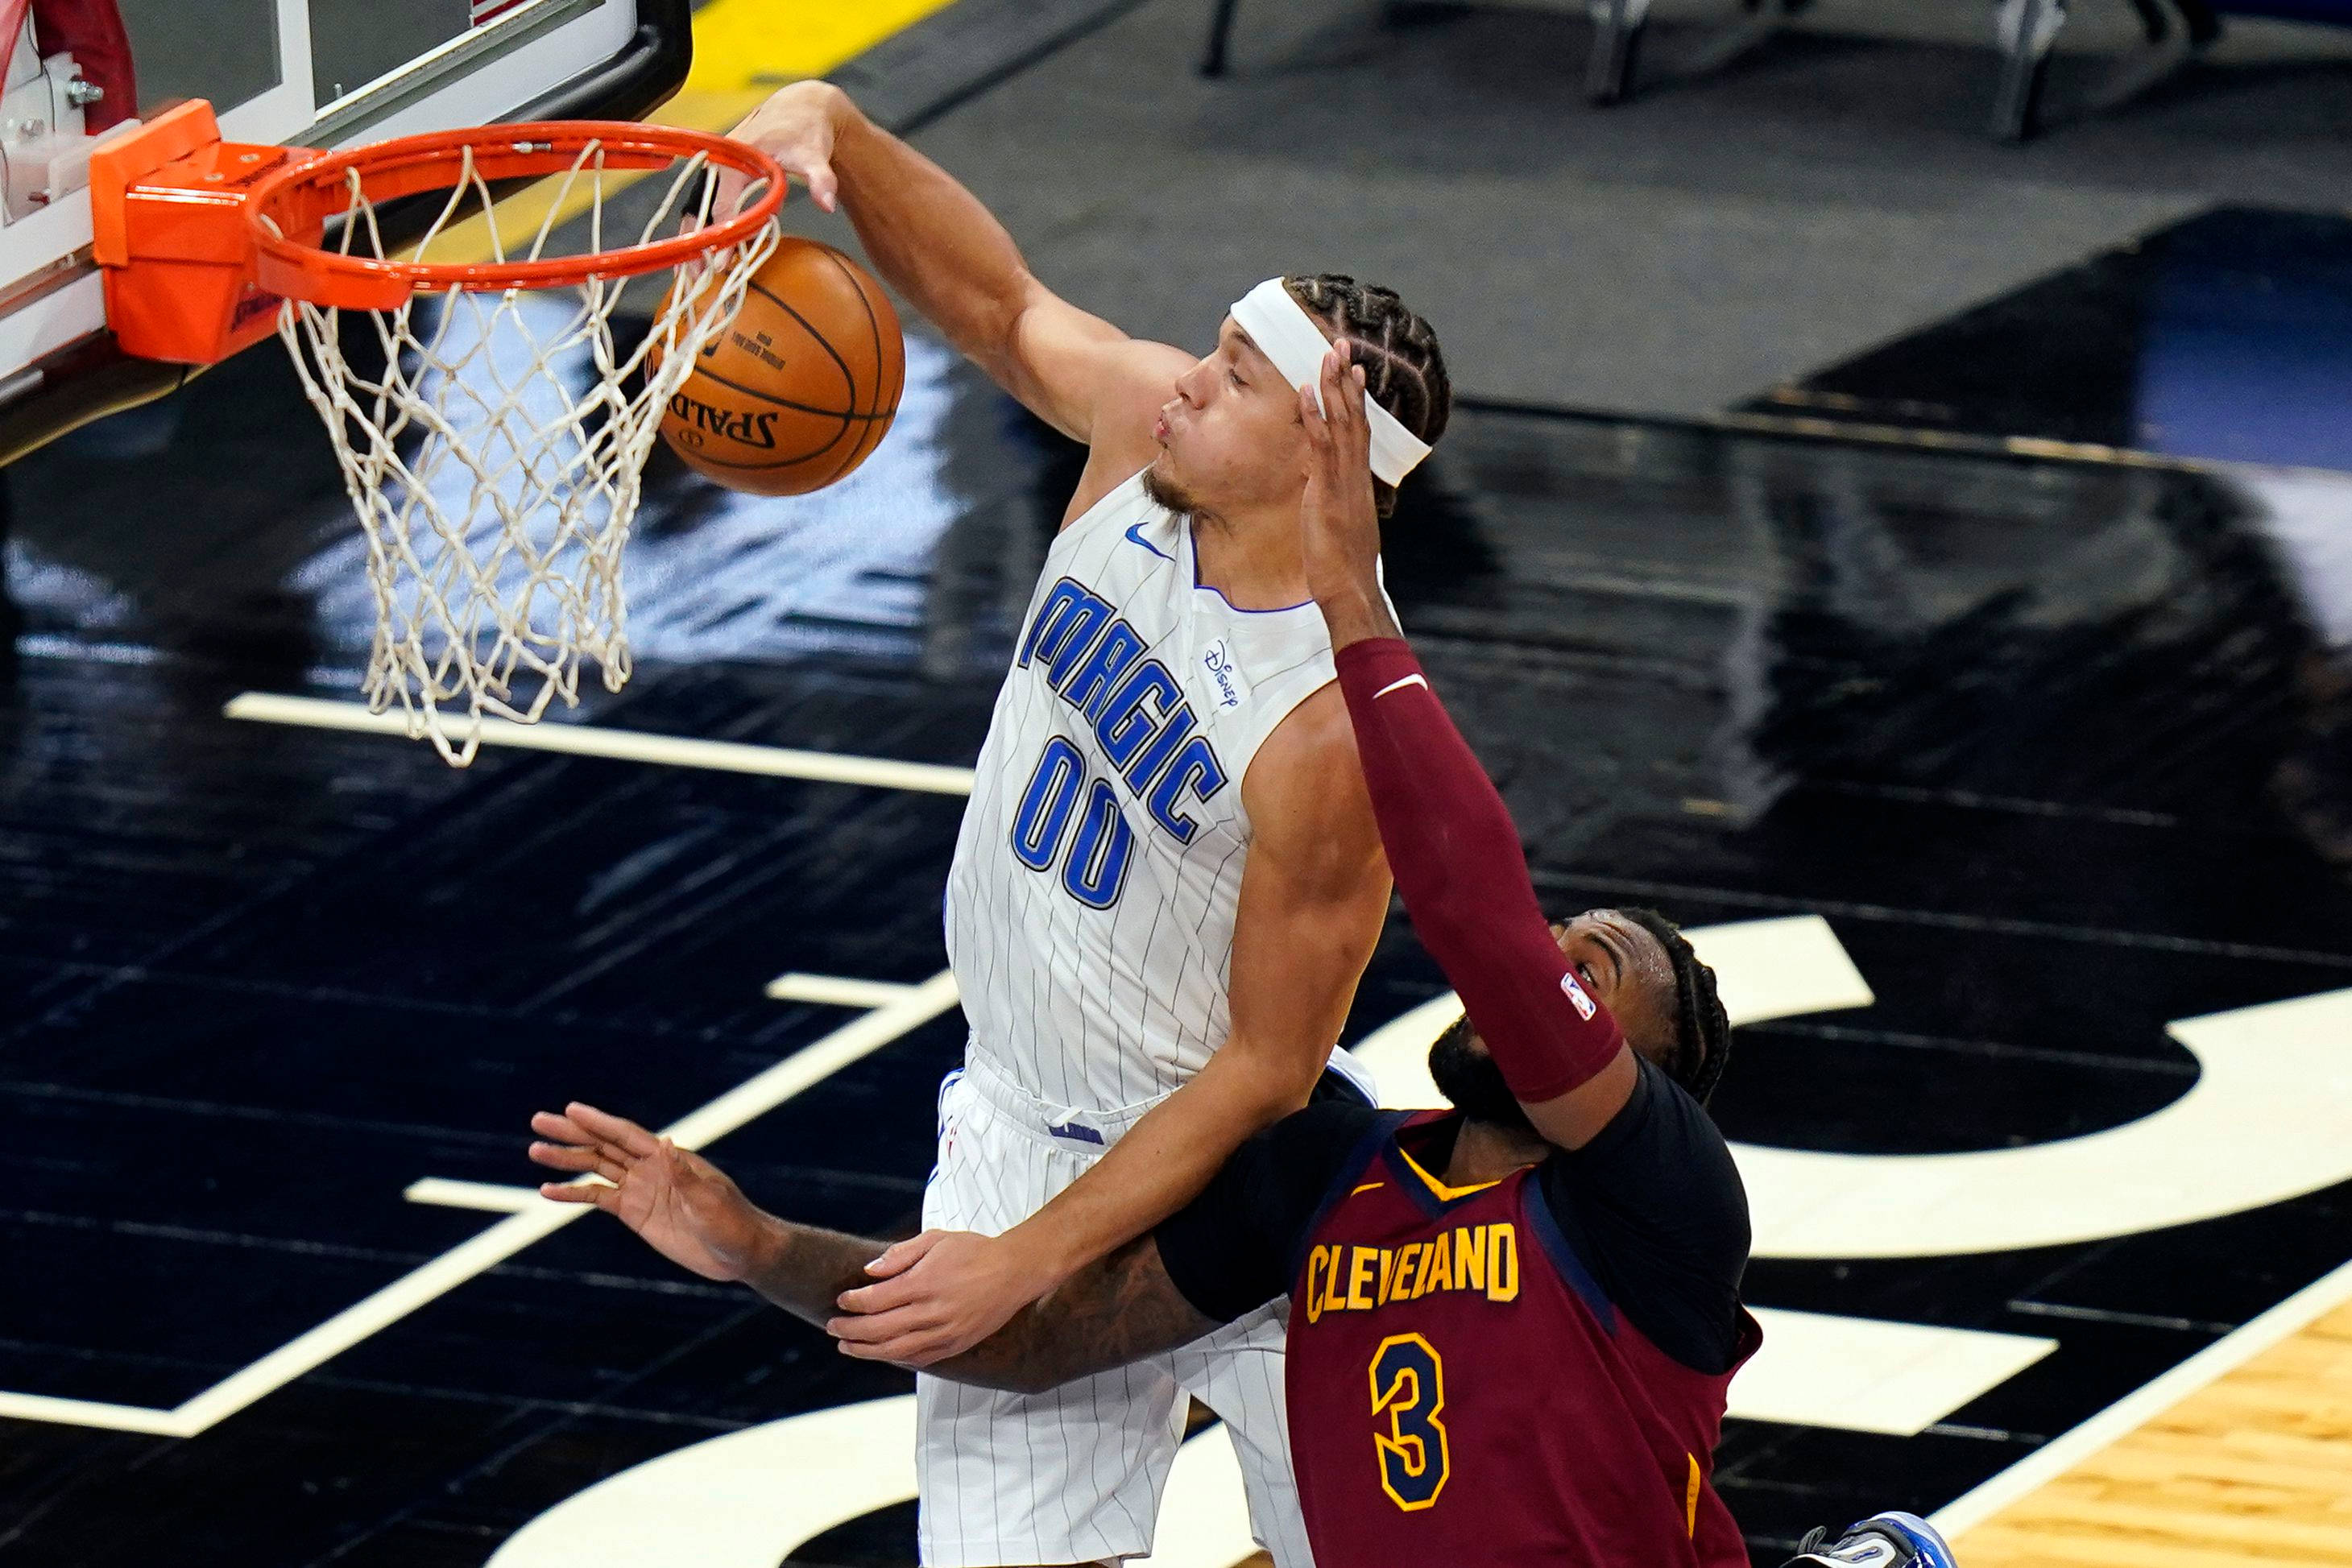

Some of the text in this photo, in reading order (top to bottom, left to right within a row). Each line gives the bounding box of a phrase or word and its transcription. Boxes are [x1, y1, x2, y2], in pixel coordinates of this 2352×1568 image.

[668, 392, 778, 449] SPALD
[1017, 576, 1228, 846] MAGIC
[1011, 734, 1135, 911] 00
[1306, 1222, 1519, 1325] CLEVELAND
[1369, 1332, 1450, 1512] 3
